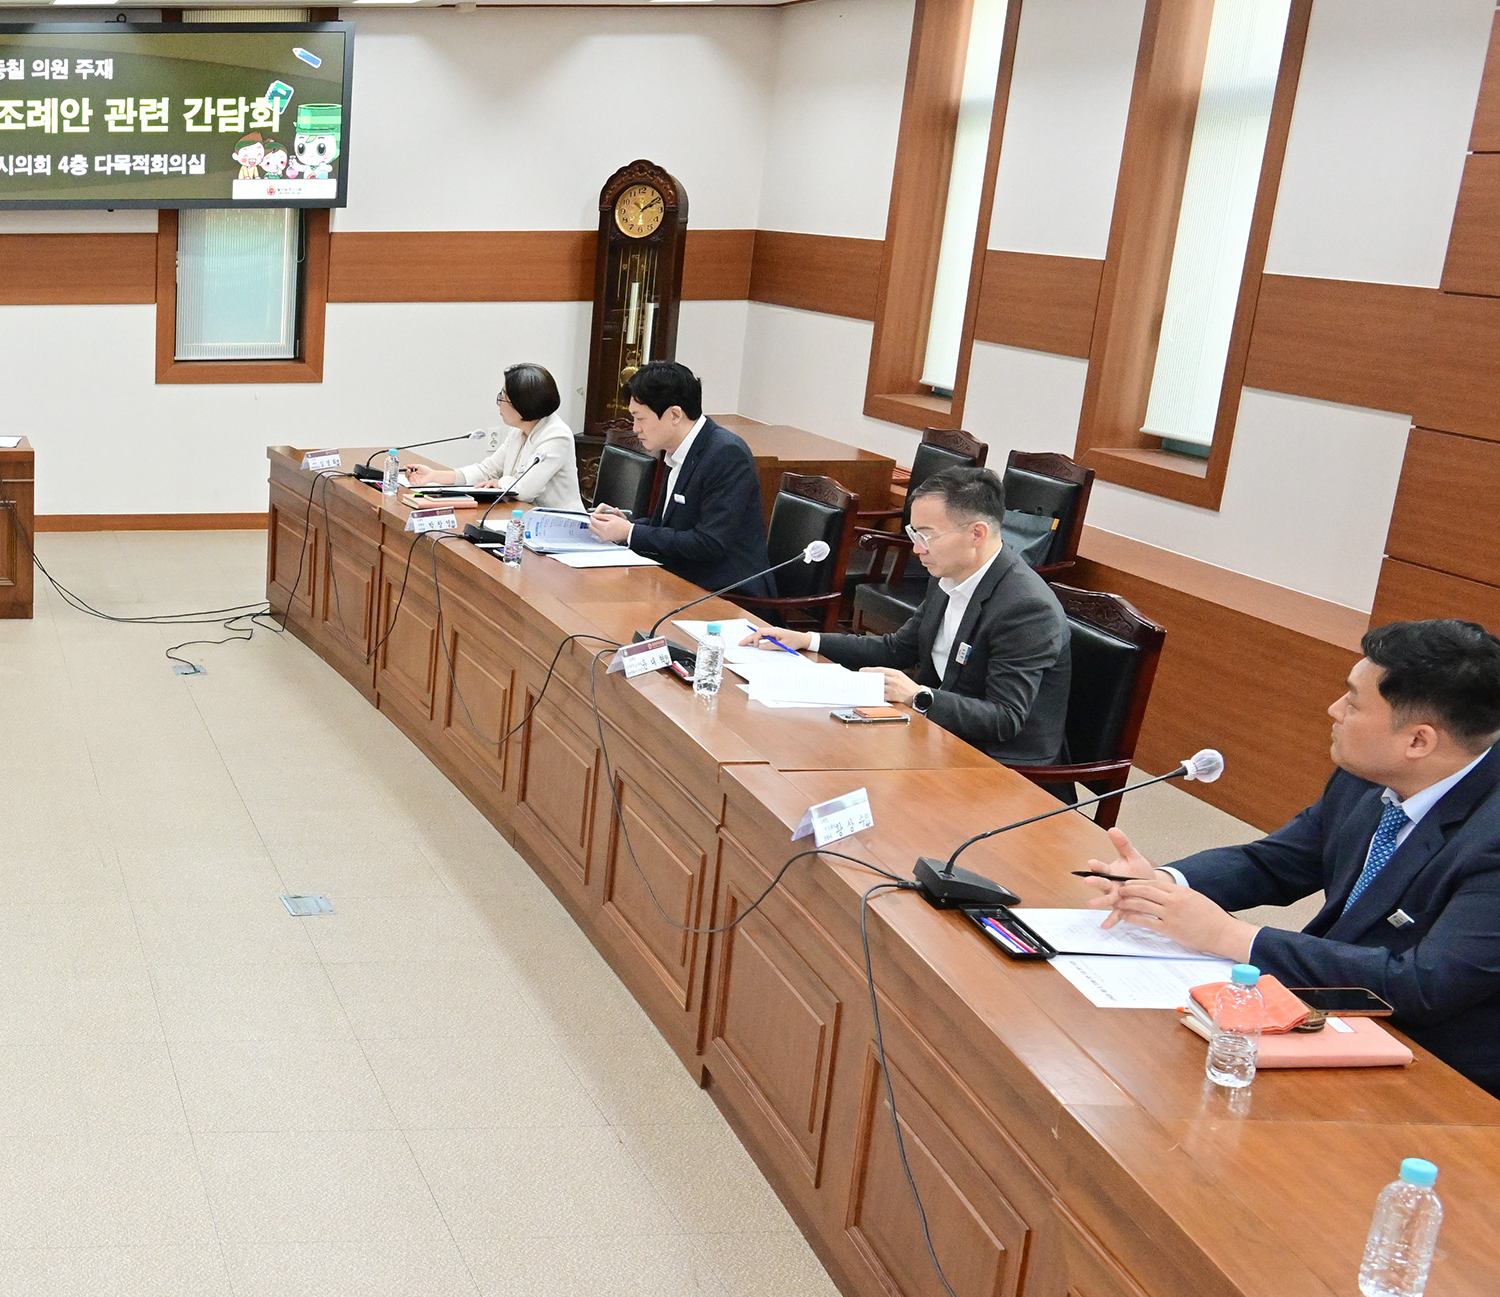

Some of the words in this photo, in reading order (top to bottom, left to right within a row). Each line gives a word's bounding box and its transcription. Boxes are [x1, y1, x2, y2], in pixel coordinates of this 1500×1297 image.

[31, 58, 69, 81] 의원
[75, 58, 114, 81] 주재
[104, 97, 170, 133] 관련
[183, 96, 282, 133] 간담회
[57, 154, 89, 176] 4층
[95, 153, 206, 176] 다목적회의실
